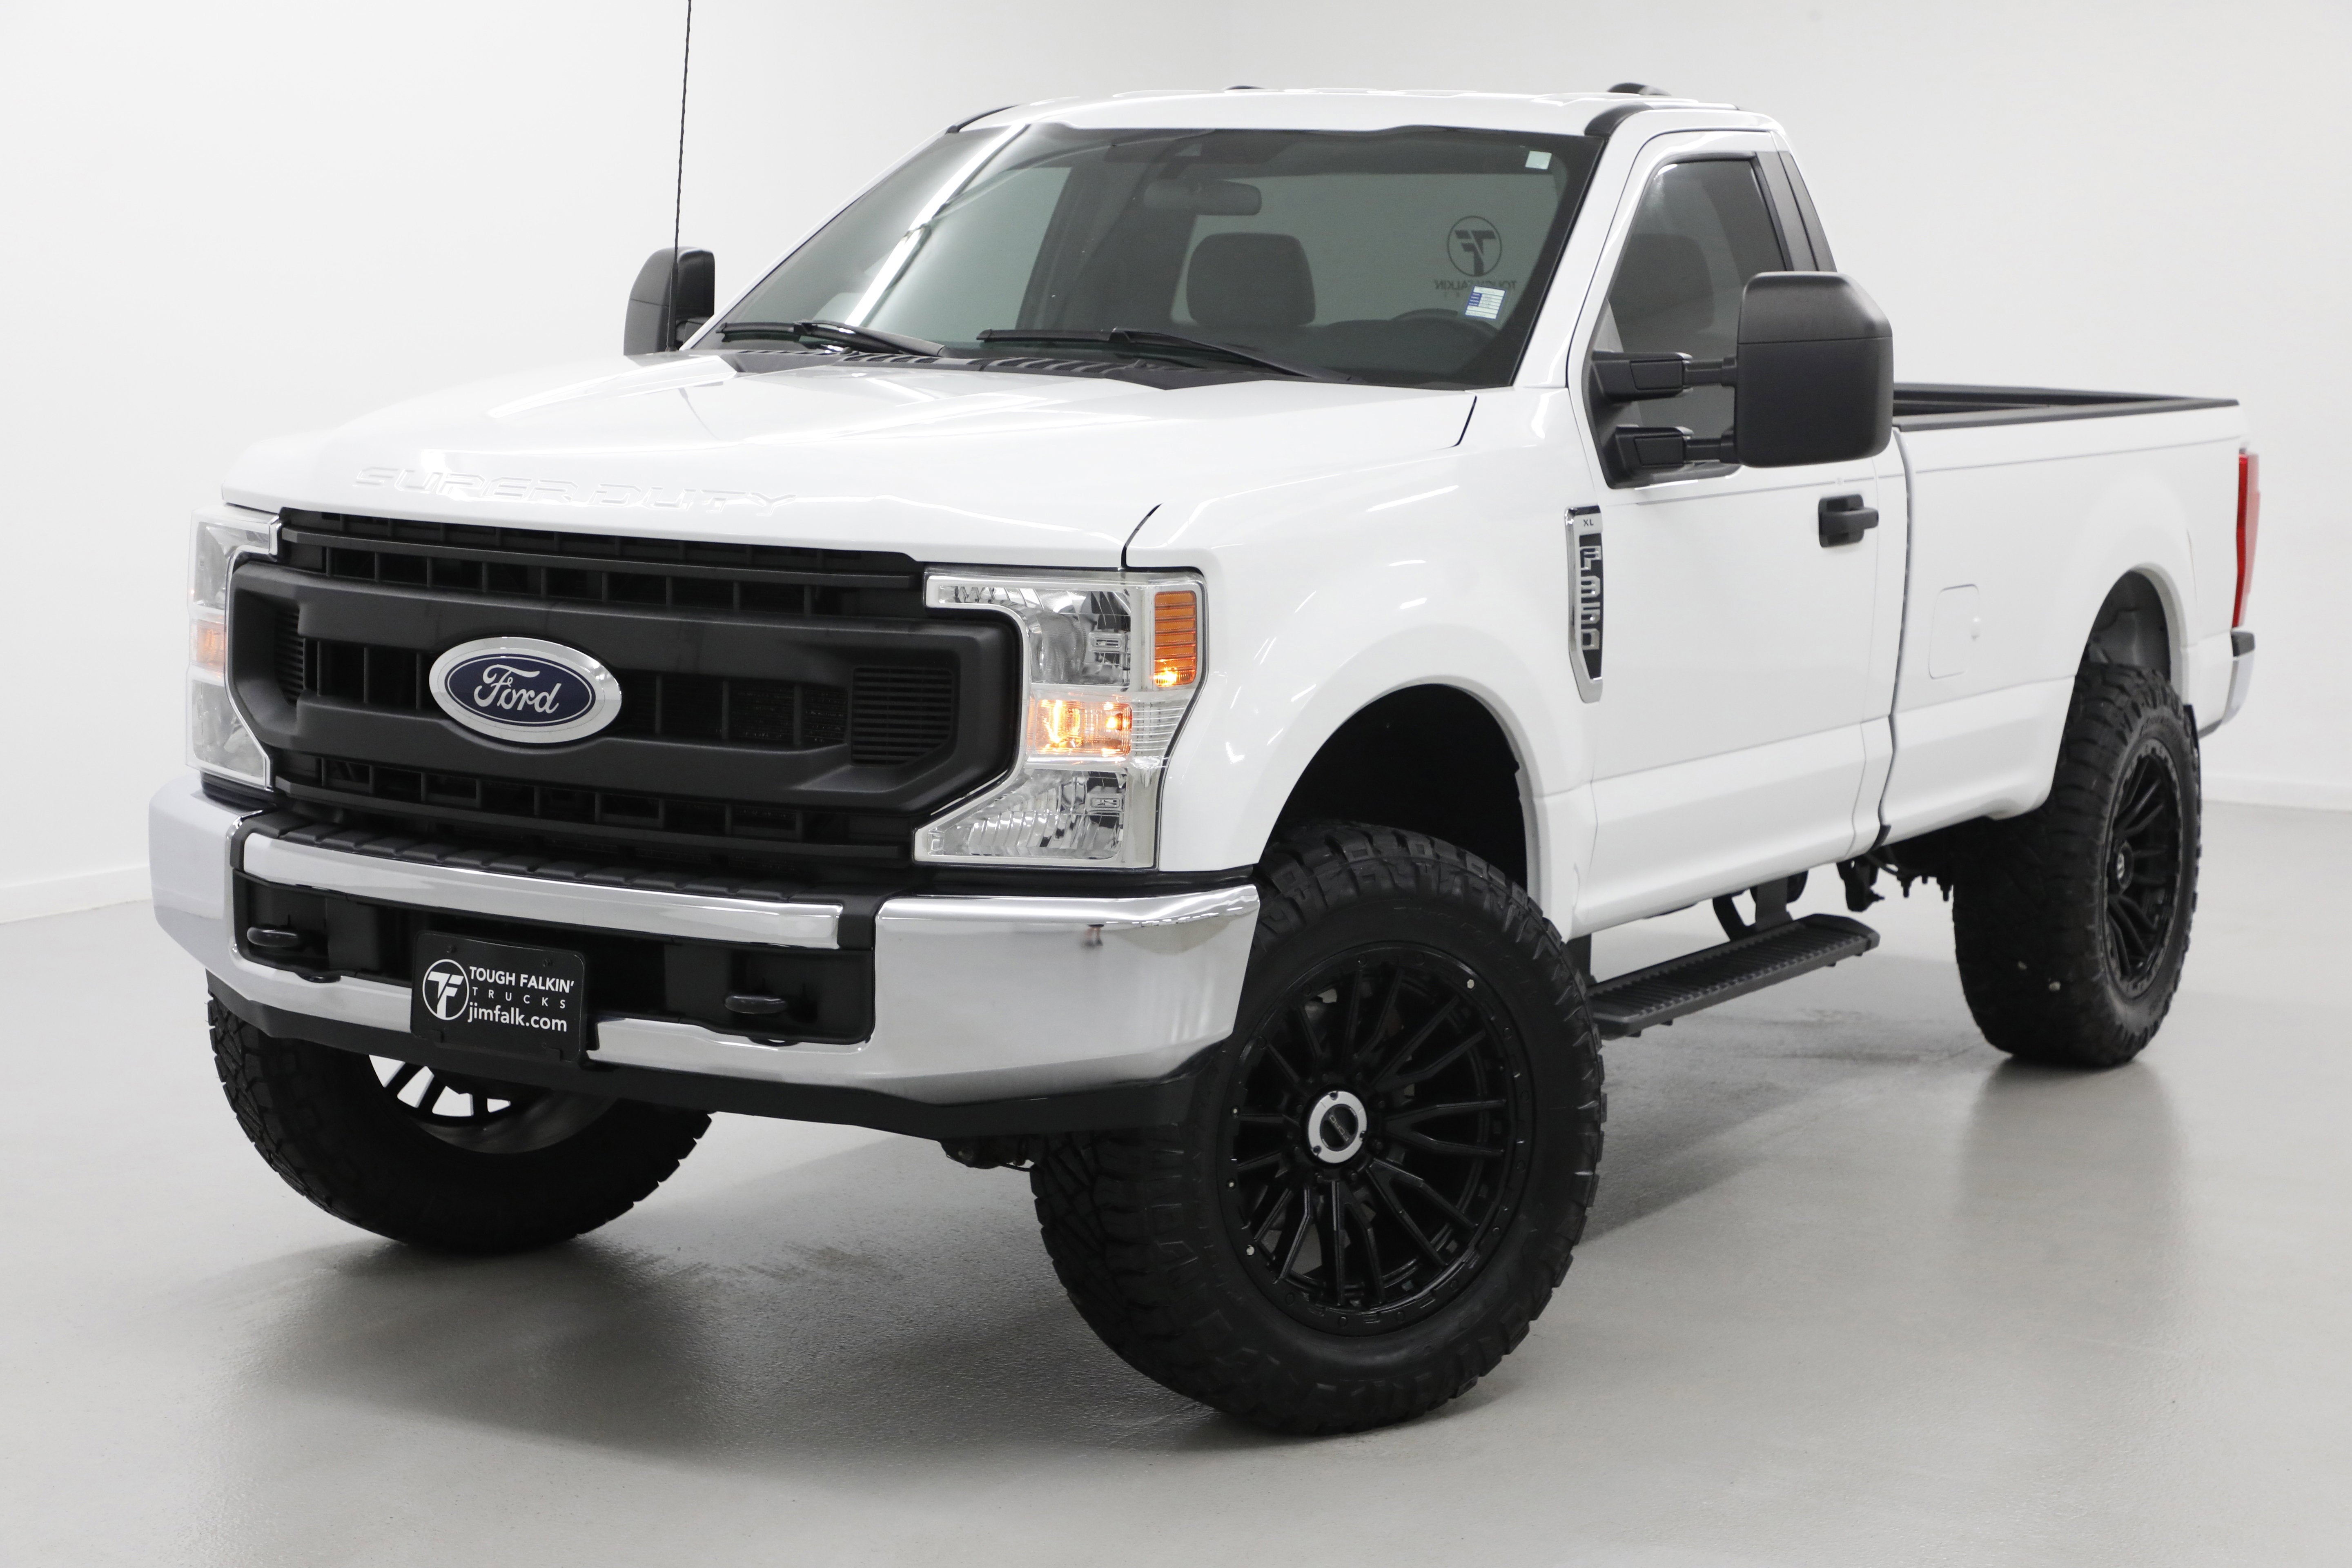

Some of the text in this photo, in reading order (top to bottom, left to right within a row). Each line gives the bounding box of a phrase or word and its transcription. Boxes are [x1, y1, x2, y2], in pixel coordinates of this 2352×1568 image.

[352, 467, 797, 516] SUPER DUTY
[1583, 519, 1594, 527] XL
[474, 664, 562, 714] Ford
[469, 966, 575, 993] TOUGH FALKIN'
[472, 987, 566, 1009] TRUCKS
[467, 1002, 567, 1032] jimfalk.com
